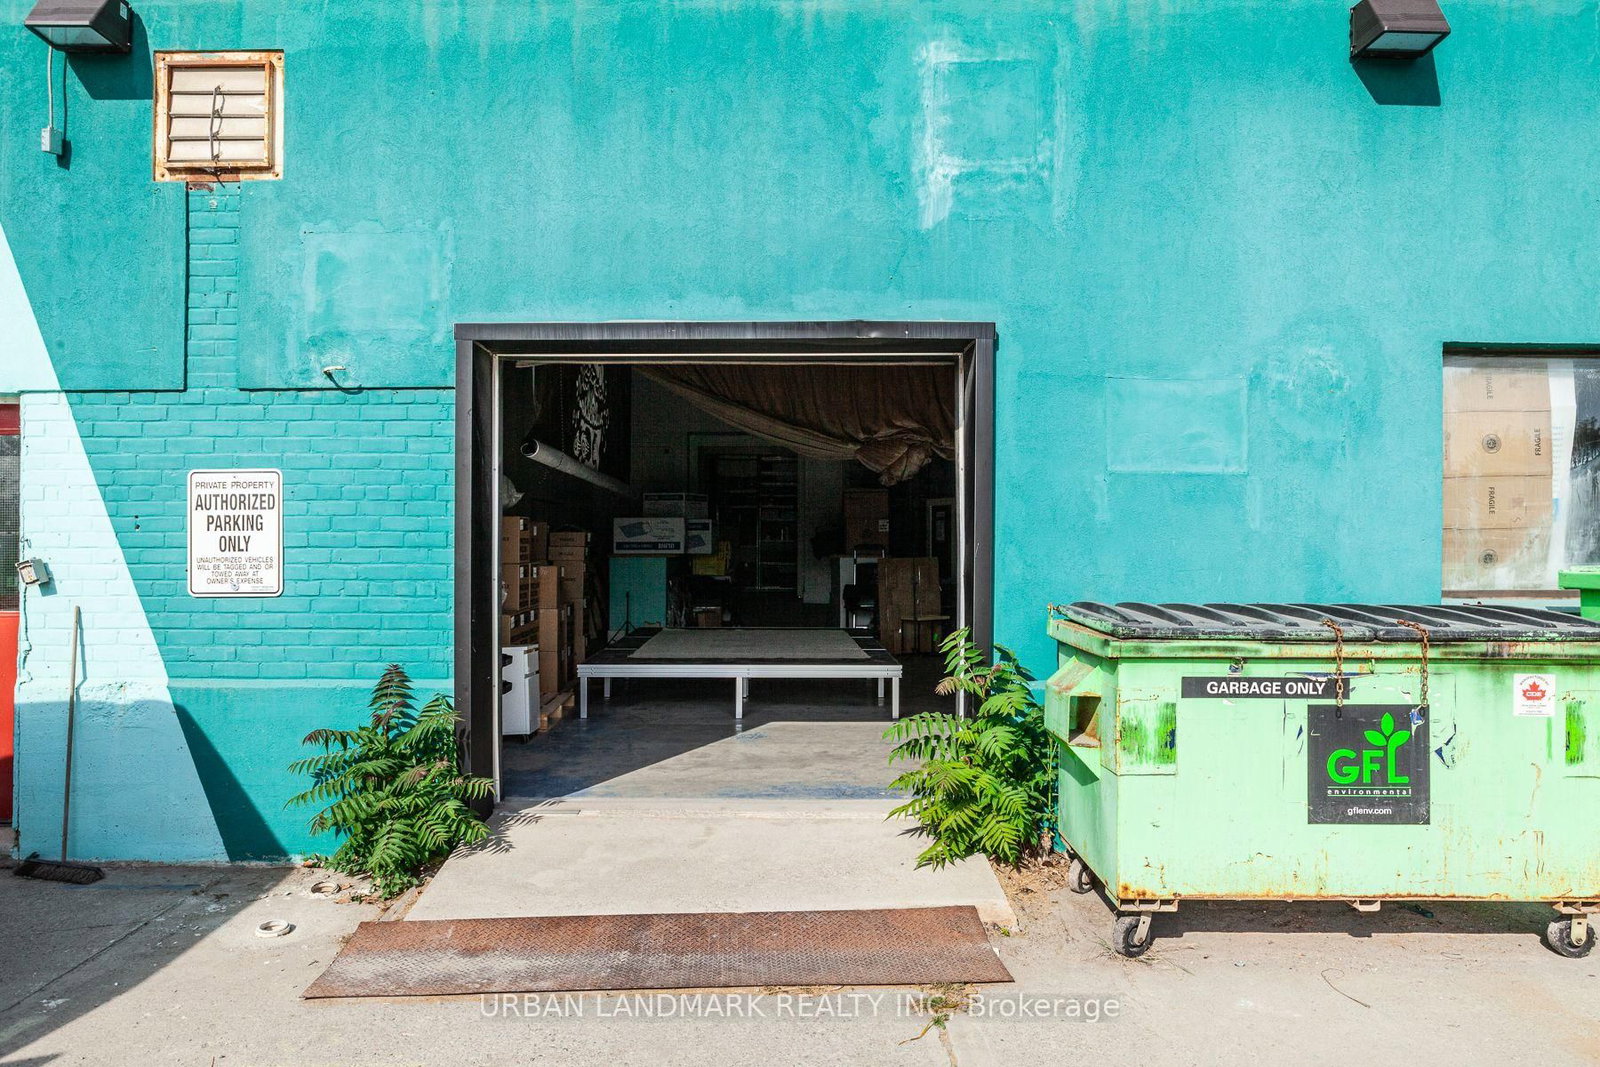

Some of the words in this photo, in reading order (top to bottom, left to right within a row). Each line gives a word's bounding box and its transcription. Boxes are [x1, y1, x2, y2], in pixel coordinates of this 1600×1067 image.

[1533, 428, 1542, 456] FRAGILE
[195, 481, 227, 489] PRIVATE
[231, 481, 274, 489] PROPERTY
[195, 493, 276, 511] AUTHORIZED
[1488, 486, 1496, 515] FRAGILE
[206, 514, 264, 532] PARKING
[219, 535, 251, 552] ONLY
[196, 556, 243, 564] UNAUTHORIZED
[245, 556, 274, 564] VEHICLES
[197, 563, 211, 571] WILL
[213, 563, 221, 571] BE
[223, 563, 247, 571] TAGGED
[249, 563, 262, 571] AND
[264, 563, 274, 571] OR
[211, 570, 233, 578] TOWED
[236, 577, 264, 585] EXPENSE
[1206, 681, 1282, 695] GARBAGE
[1285, 681, 1326, 695] ONLY
[1326, 731, 1411, 784] GFL
[1327, 788, 1412, 796] environmental
[1347, 806, 1392, 816] gflenv.com
